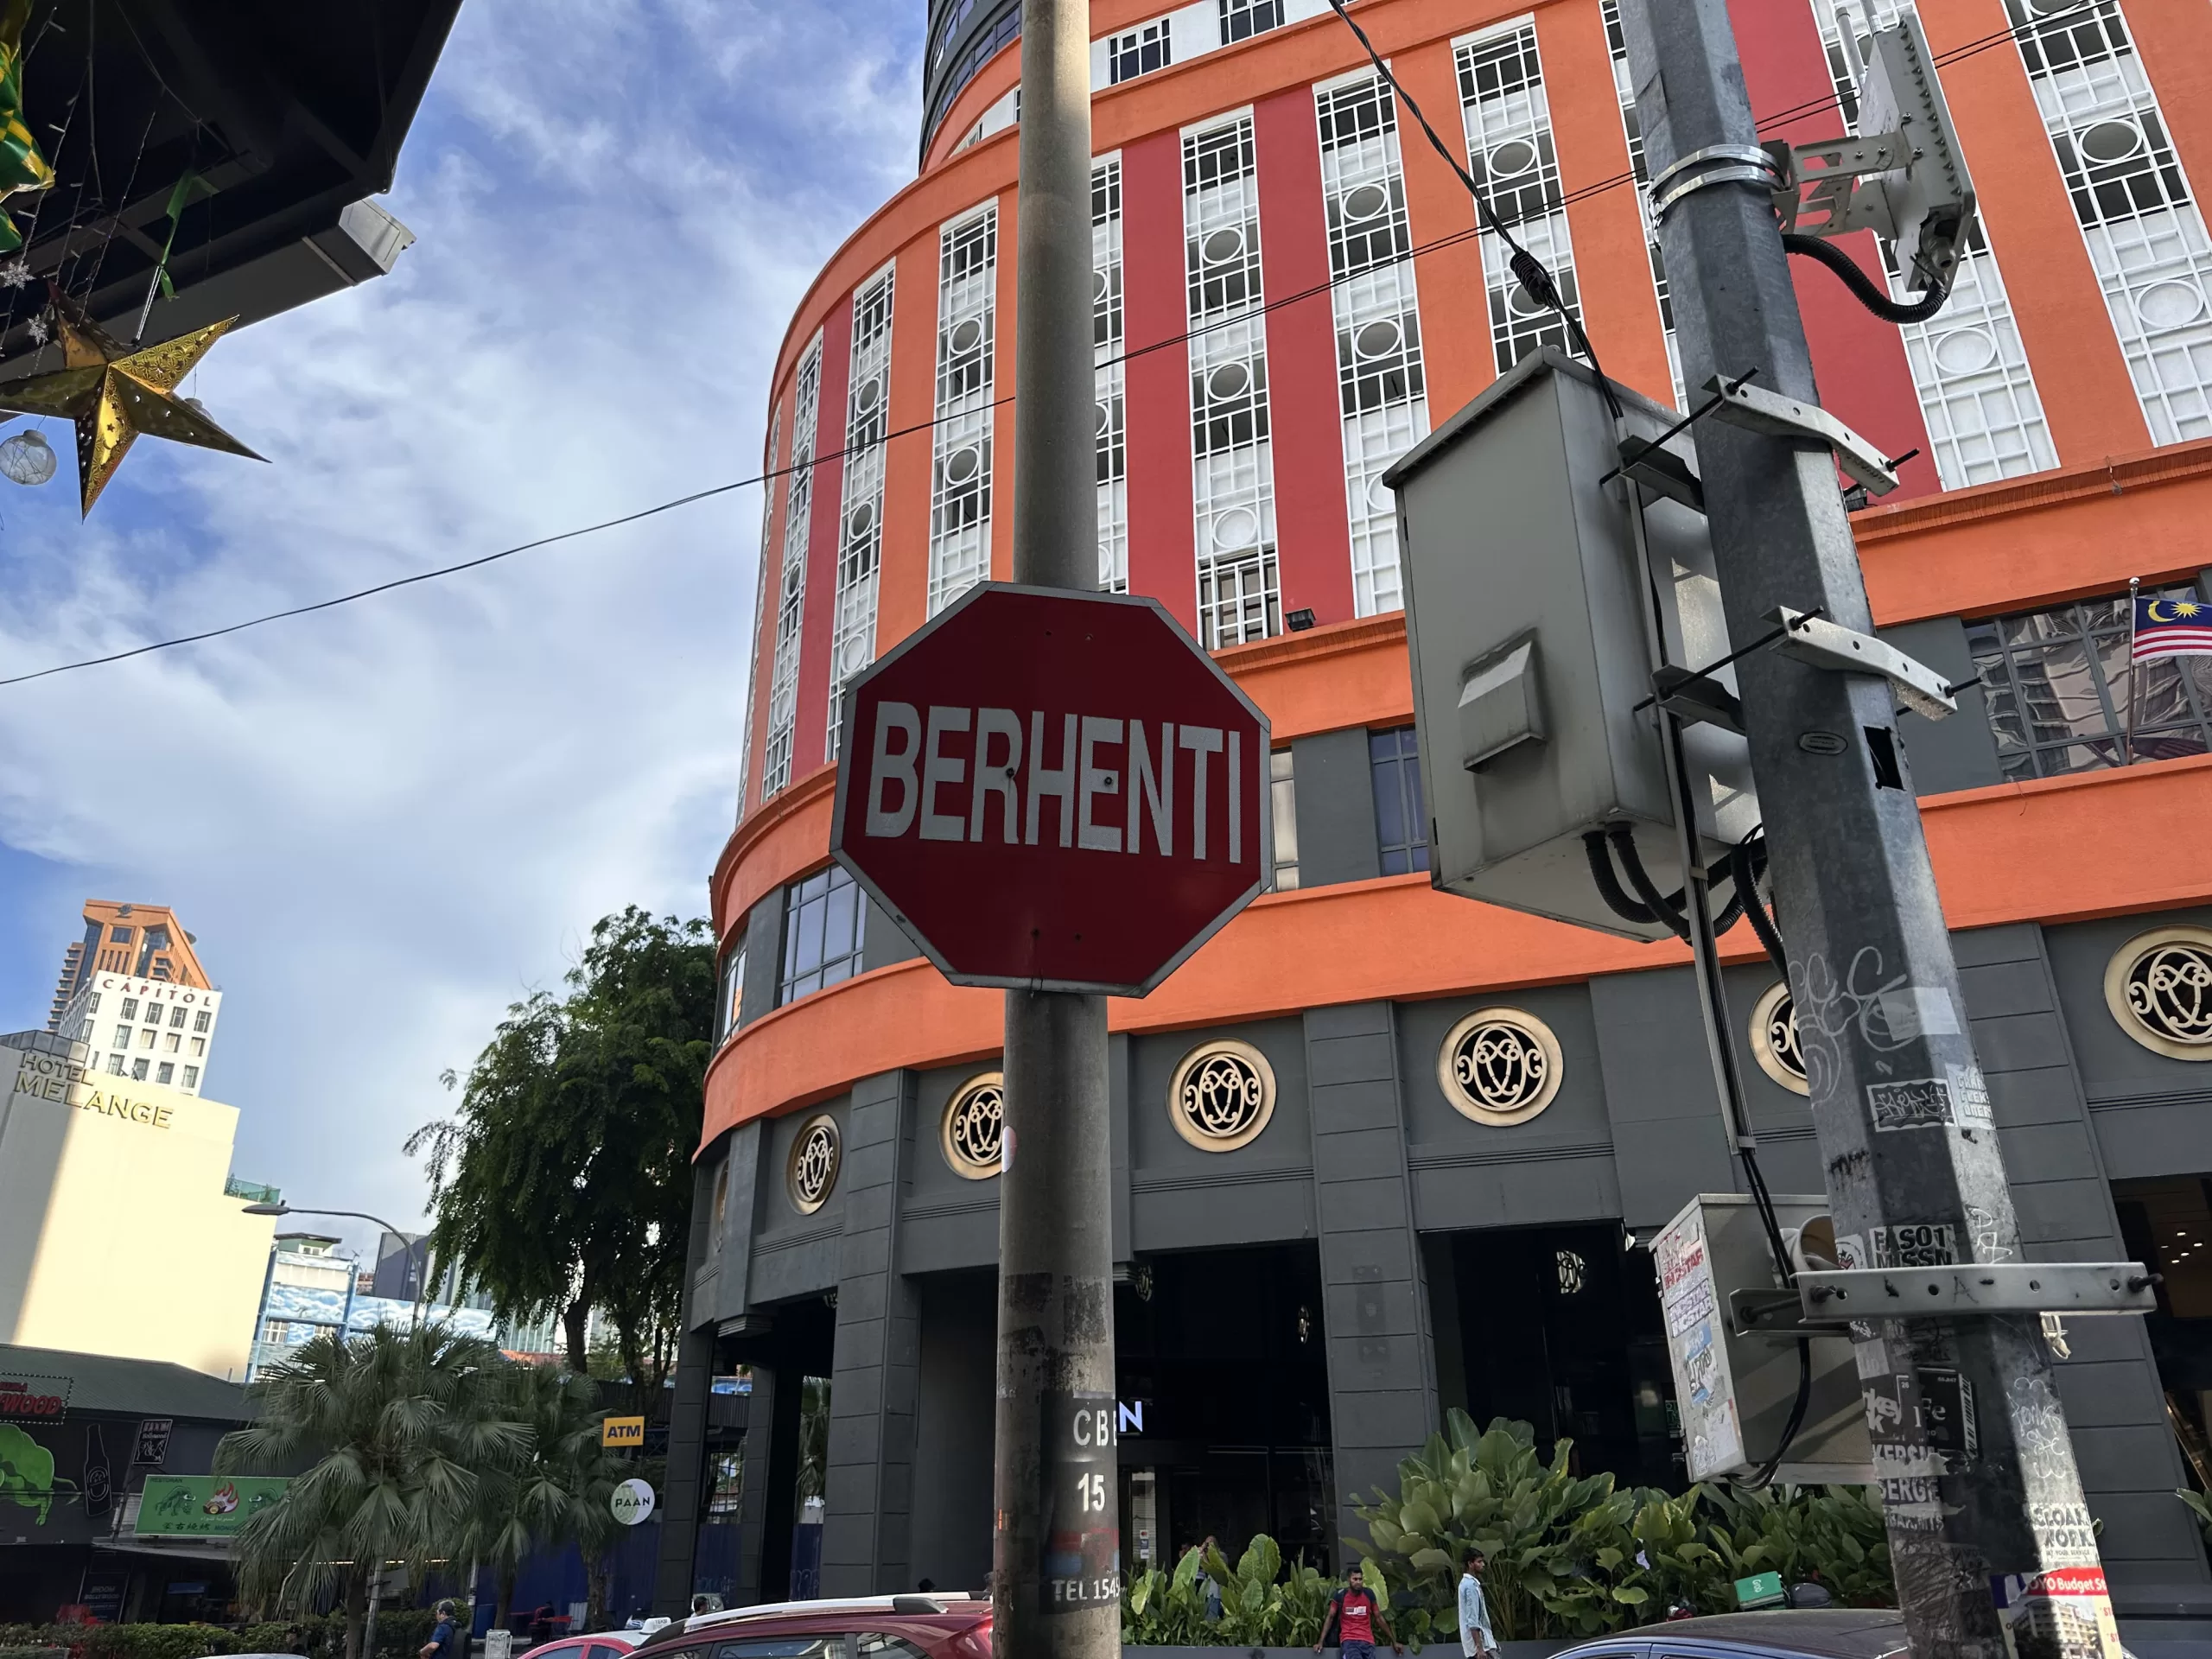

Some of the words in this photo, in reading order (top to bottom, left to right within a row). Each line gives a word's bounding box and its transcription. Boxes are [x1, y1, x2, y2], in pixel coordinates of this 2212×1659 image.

[865, 701, 1242, 864] BERHENTI
[103, 978, 212, 1007] CAPITOL
[19, 1052, 94, 1086] HOTEL
[13, 1071, 174, 1129] MELANGE
[607, 1425, 641, 1439] ATM
[614, 1497, 651, 1507] PAAN
[1077, 1472, 1106, 1511] 15
[1052, 1580, 1088, 1601] TEL
[1751, 1579, 1764, 1593] Grab
[2057, 1576, 2094, 1593] Budget
